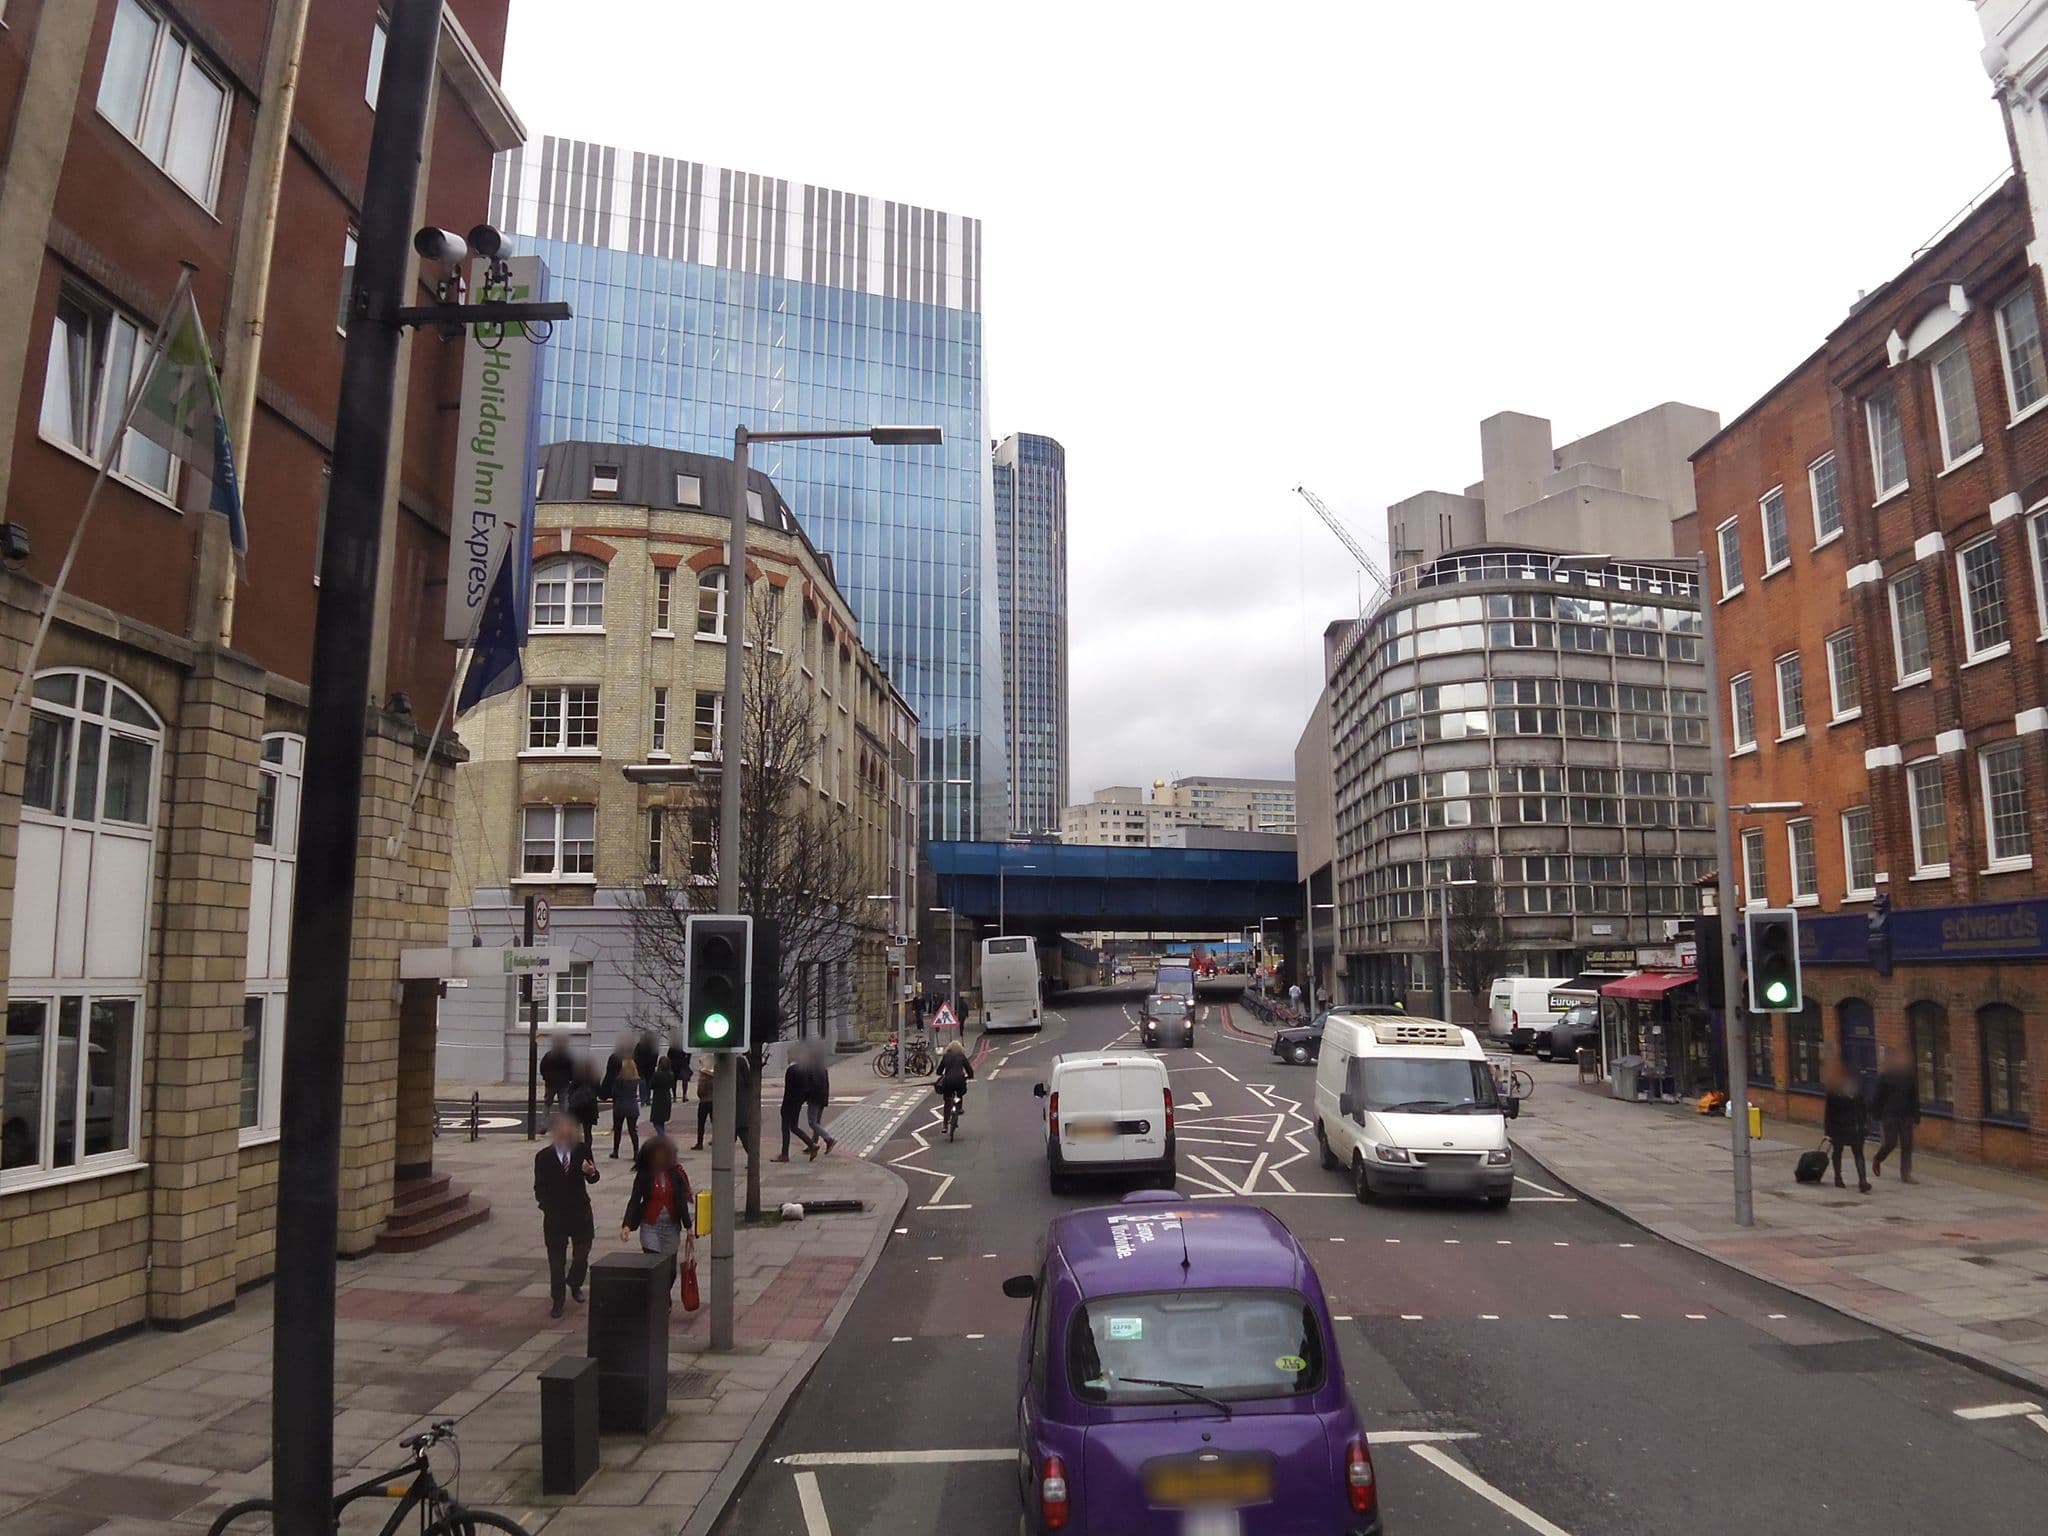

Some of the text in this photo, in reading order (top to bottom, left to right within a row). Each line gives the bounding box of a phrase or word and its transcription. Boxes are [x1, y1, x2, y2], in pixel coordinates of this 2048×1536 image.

[464, 348, 512, 609] Holiday Inn Express
[537, 906, 547, 921] 20
[1941, 906, 2039, 940] edwards
